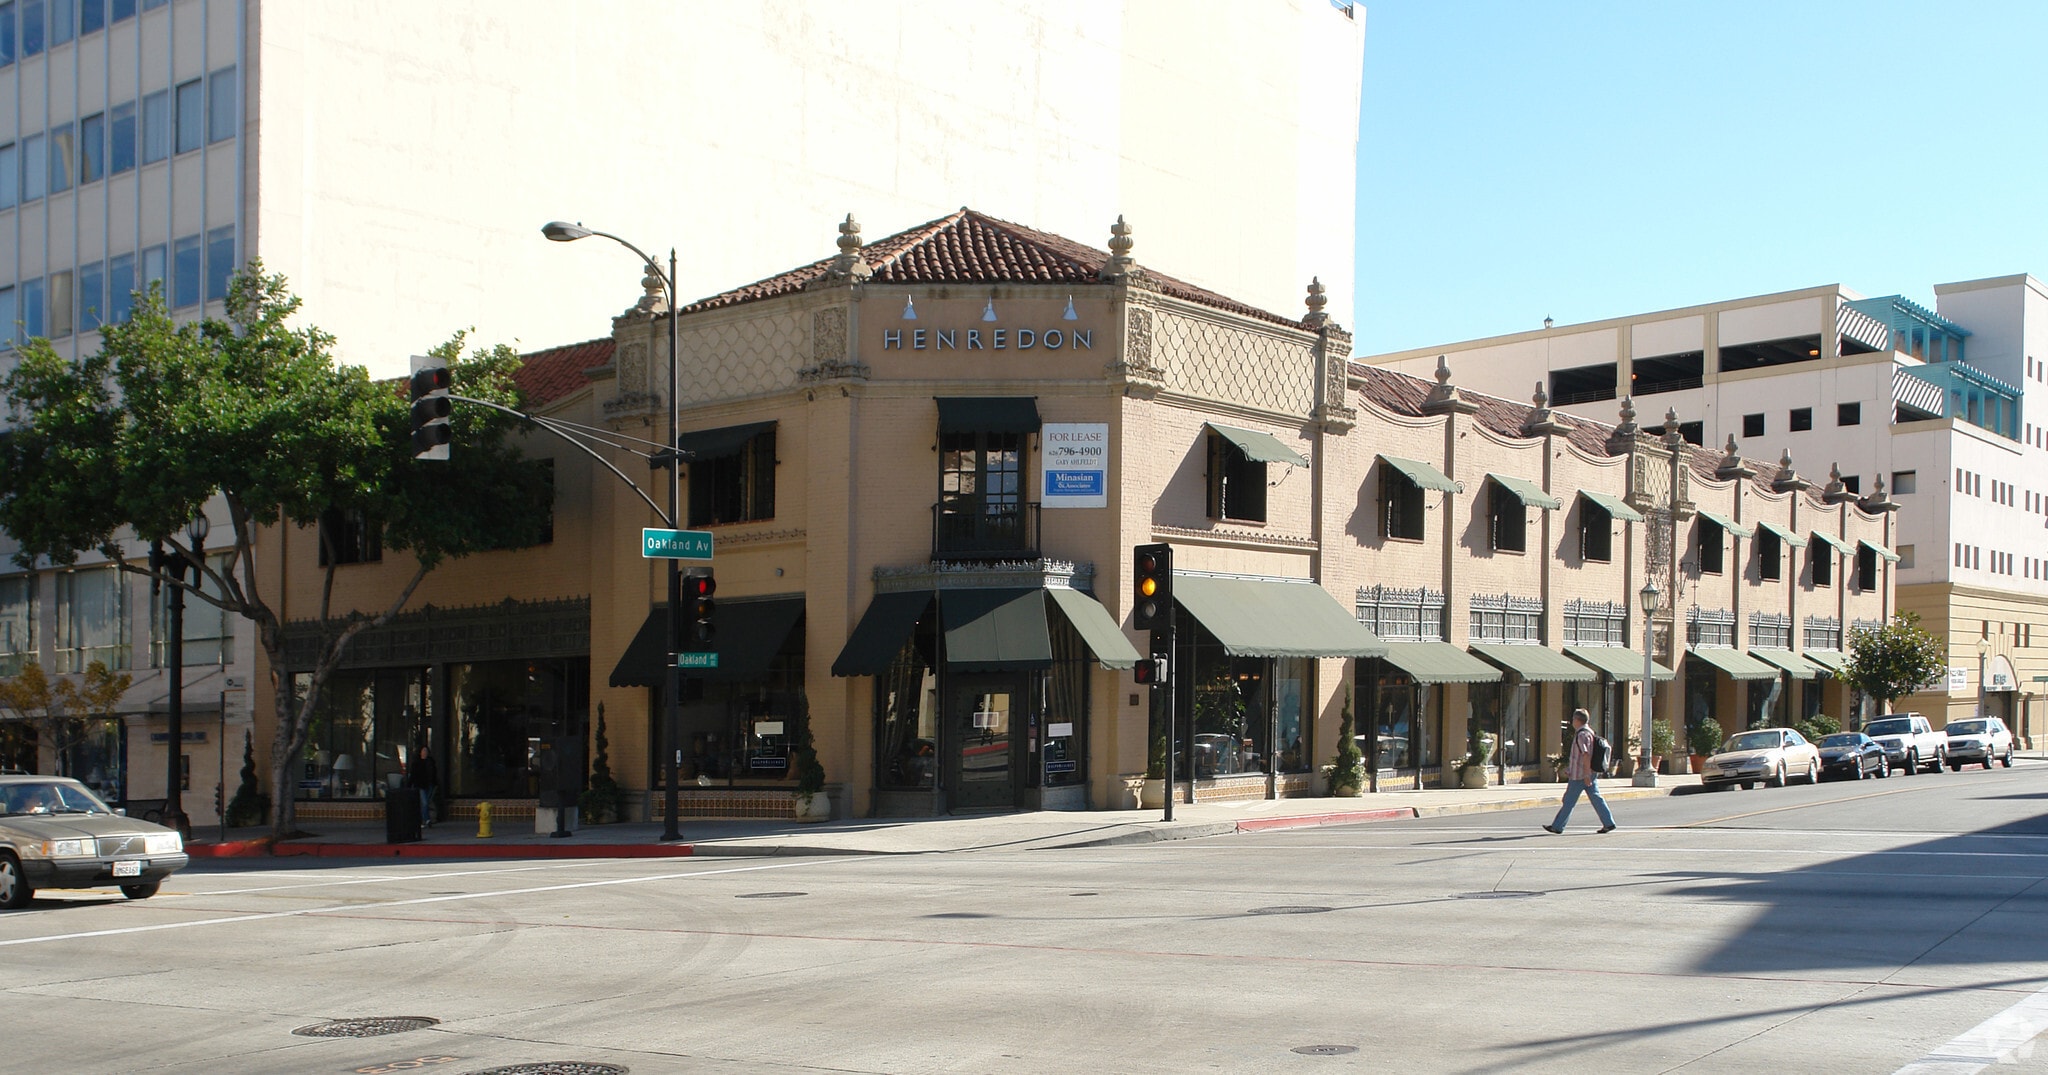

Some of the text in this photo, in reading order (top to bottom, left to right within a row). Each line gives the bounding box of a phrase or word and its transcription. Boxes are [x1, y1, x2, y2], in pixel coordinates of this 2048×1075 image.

[884, 329, 1093, 350] HENREDON
[1049, 432, 1102, 441] FOR LEASE
[1058, 447, 1102, 456] 796-4900
[1055, 473, 1094, 482] Minasian
[647, 537, 709, 551] Oakland Av
[680, 653, 707, 665] Oakland
